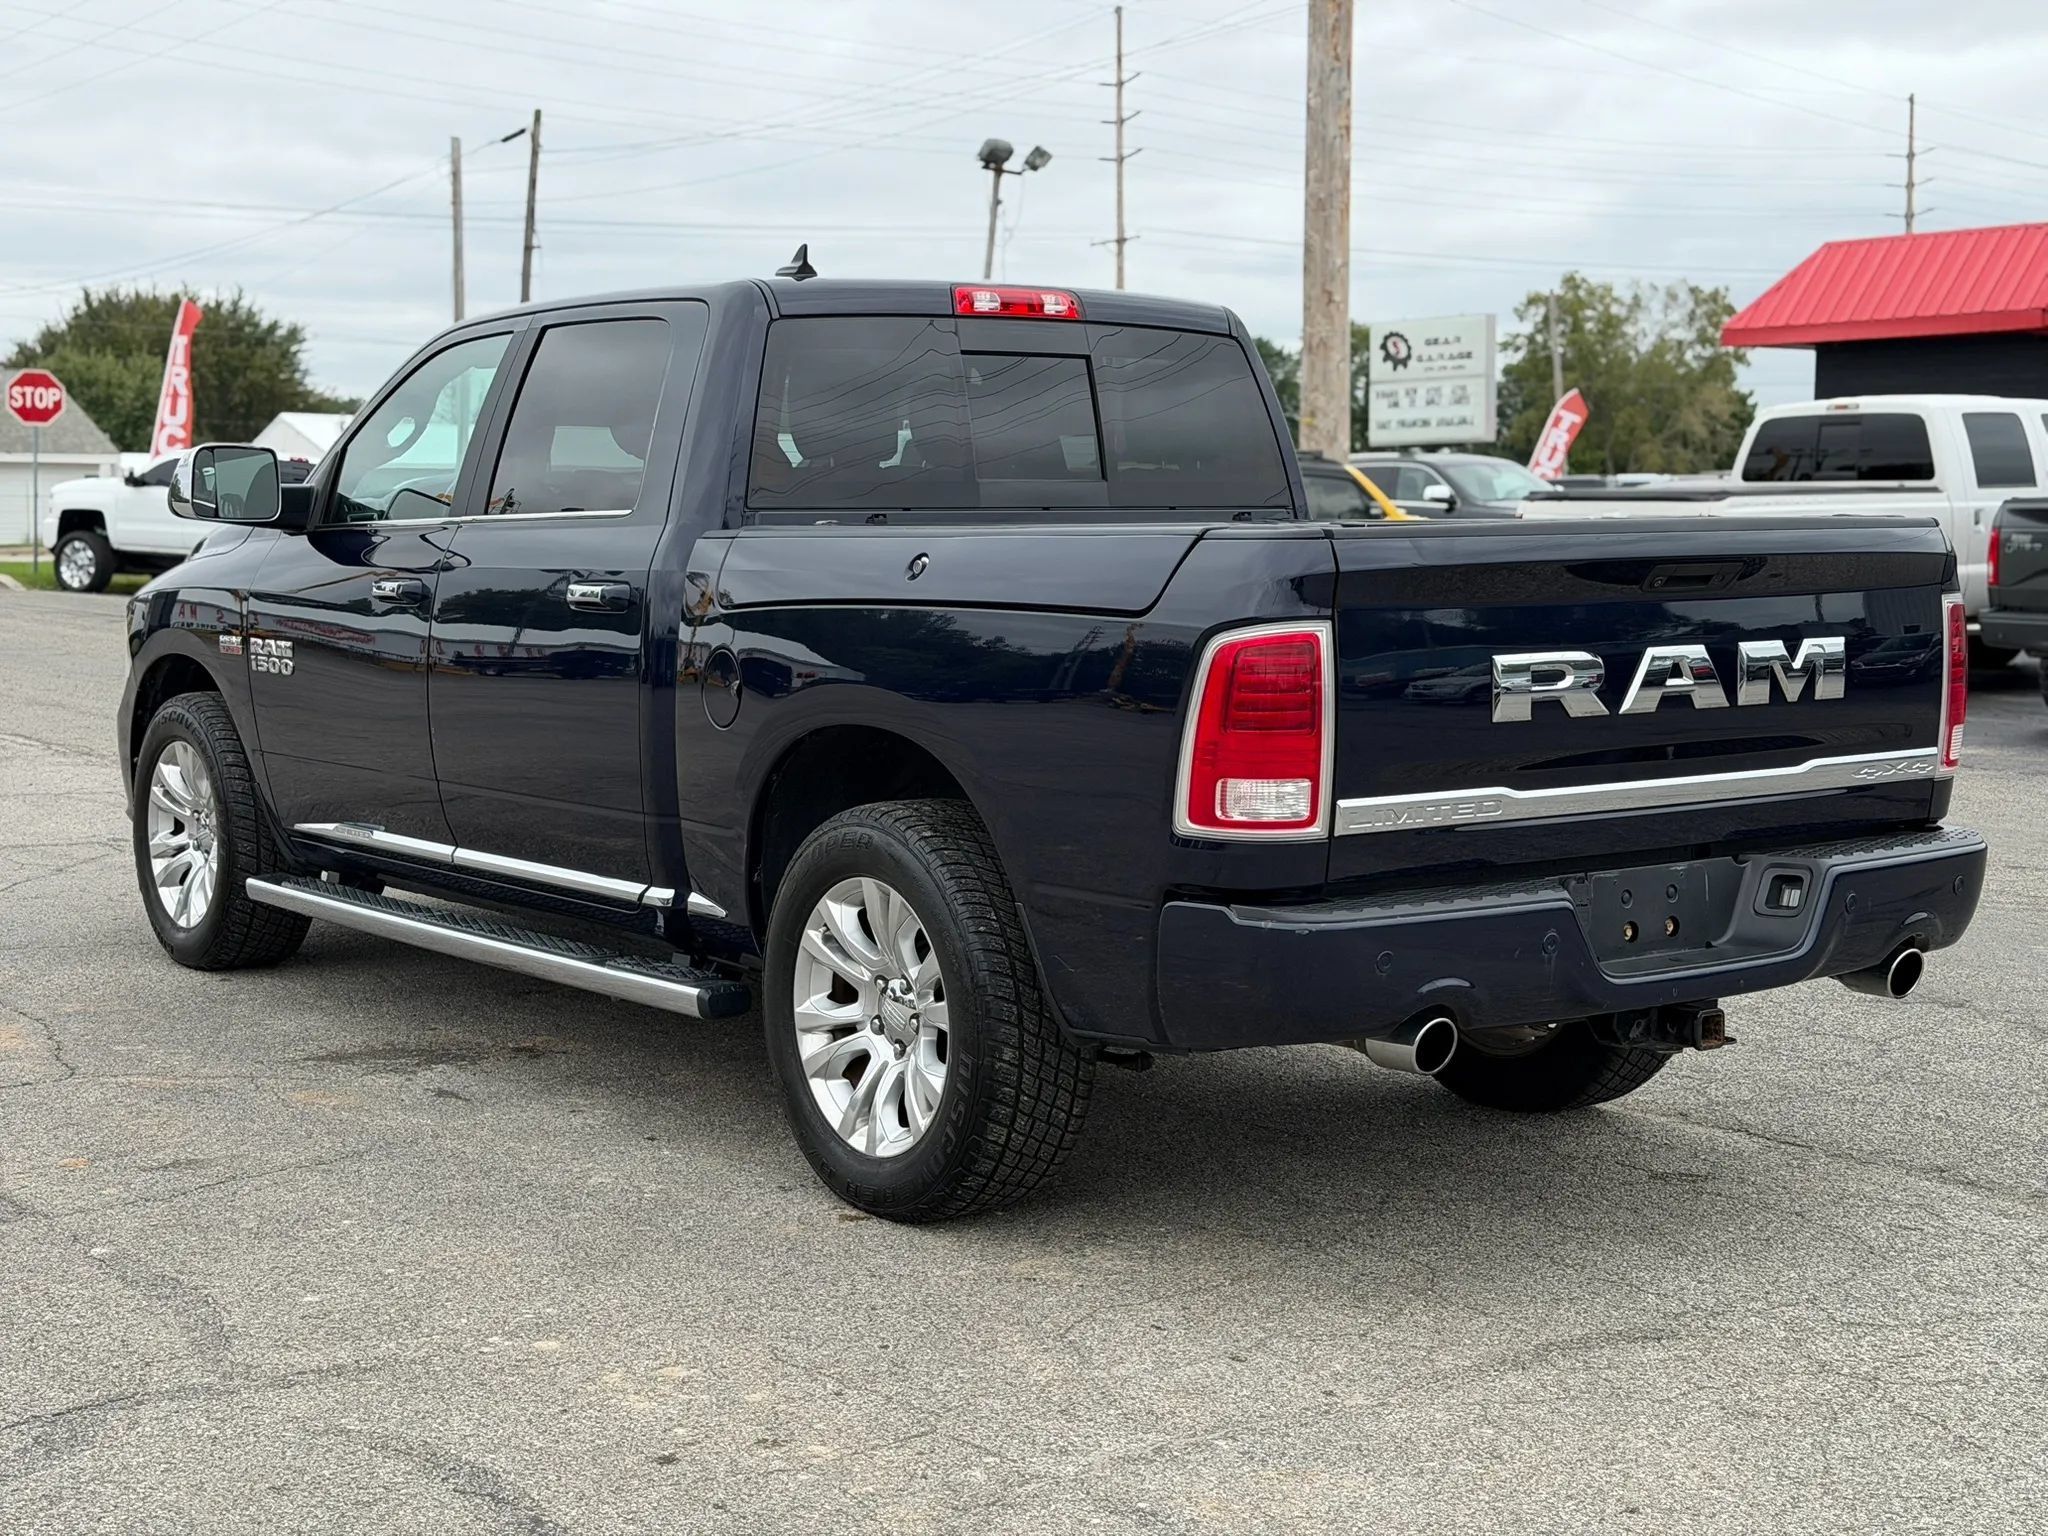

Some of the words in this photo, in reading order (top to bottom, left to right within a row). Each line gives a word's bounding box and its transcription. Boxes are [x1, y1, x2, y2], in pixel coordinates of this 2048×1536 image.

[10, 385, 61, 410] STOP
[249, 636, 294, 657] RAM
[250, 655, 294, 676] 1500
[1491, 636, 1846, 723] RAM
[1348, 800, 1503, 828] LIMITED
